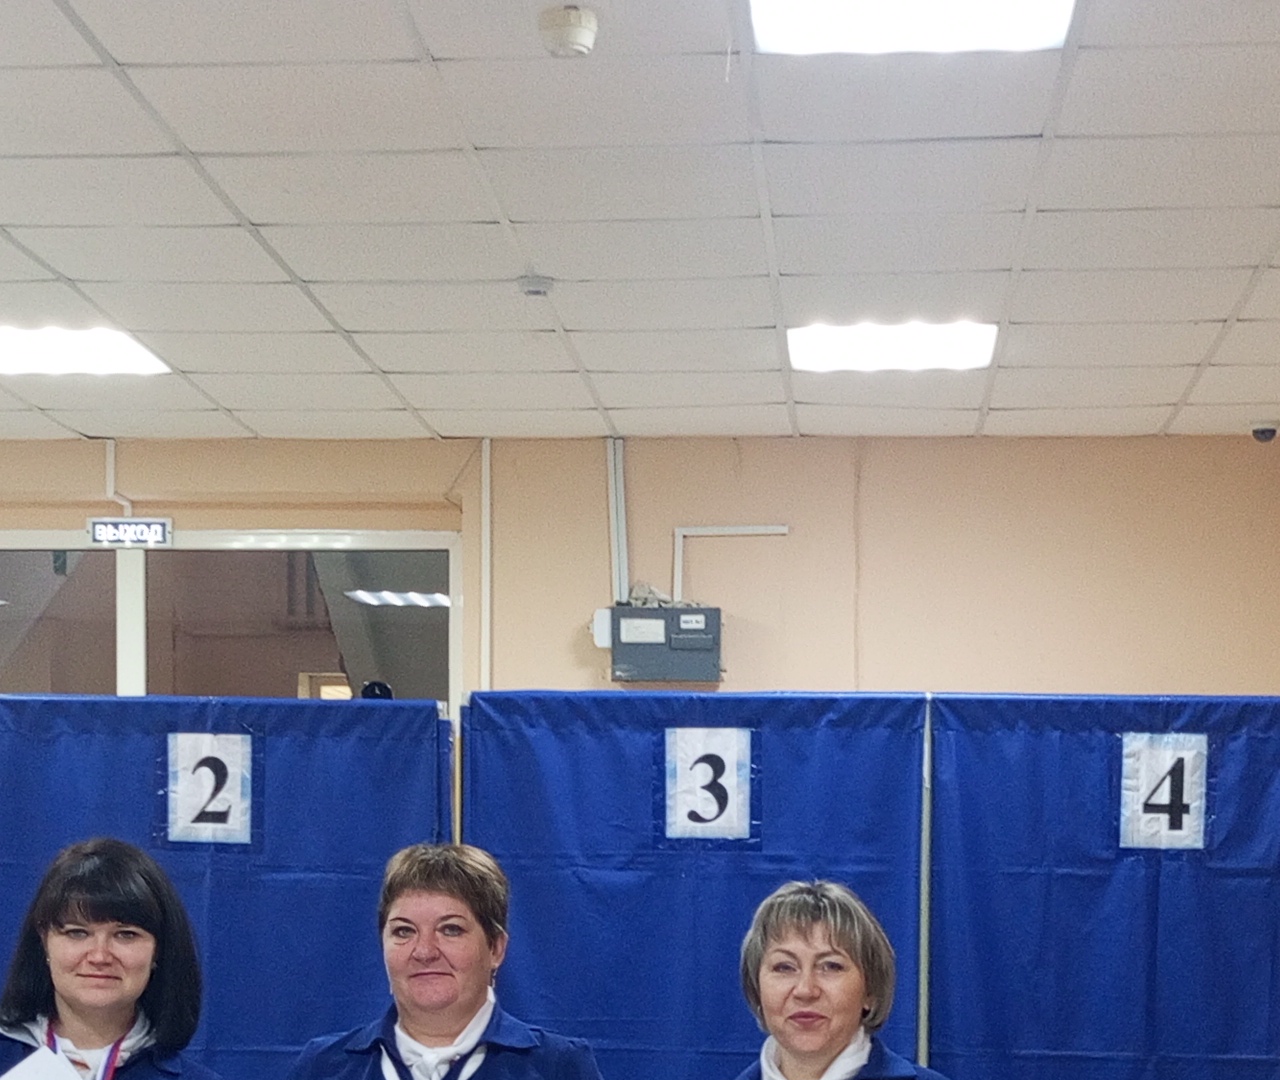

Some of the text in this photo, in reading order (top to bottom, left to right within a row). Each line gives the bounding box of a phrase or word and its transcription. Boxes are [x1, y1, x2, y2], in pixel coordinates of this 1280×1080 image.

[94, 523, 163, 541] ВЫХОД
[190, 756, 232, 824] 2
[687, 753, 729, 824] 3
[1143, 757, 1190, 831] 4
